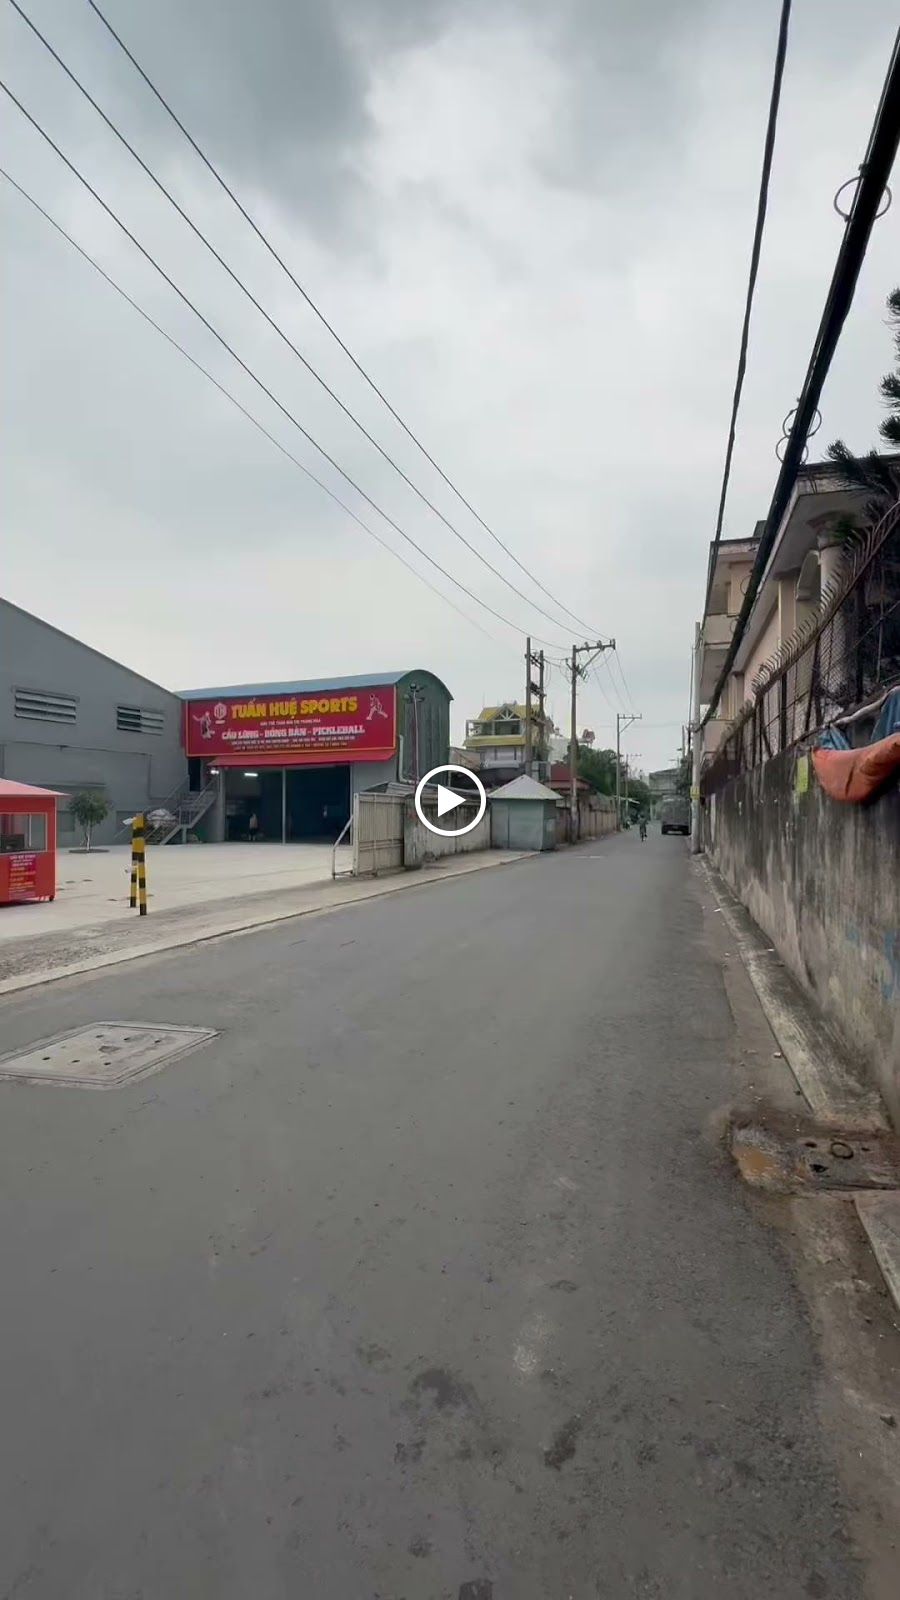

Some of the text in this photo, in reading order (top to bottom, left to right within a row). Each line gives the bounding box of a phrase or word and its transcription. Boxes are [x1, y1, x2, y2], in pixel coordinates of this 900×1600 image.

[231, 696, 358, 719] TUẤN HUỆ SPORTS
[312, 725, 365, 735] PICKLEBALL
